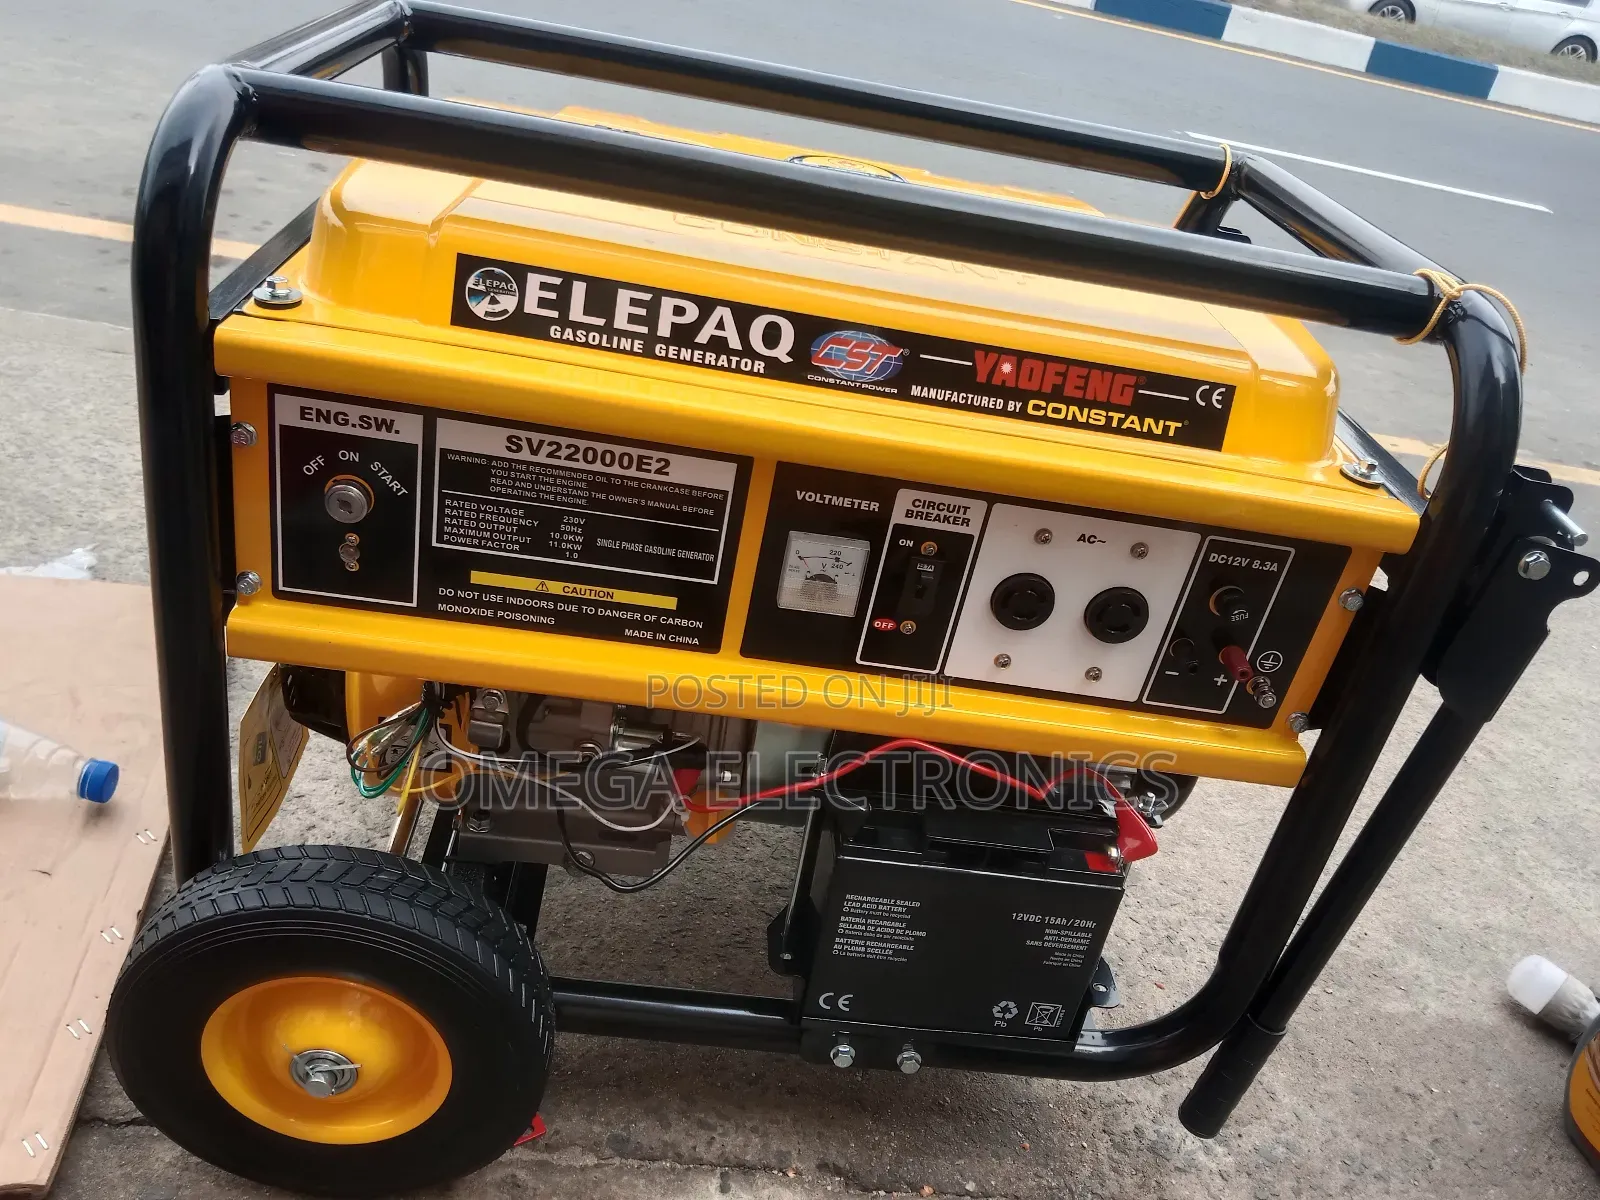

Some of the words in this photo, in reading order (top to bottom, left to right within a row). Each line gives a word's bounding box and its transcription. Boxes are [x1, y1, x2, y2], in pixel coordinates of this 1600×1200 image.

[472, 278, 516, 291] ELEPAQ
[524, 272, 795, 362] ELEPAQ
[549, 325, 644, 353] GASOLINE
[654, 344, 766, 374] GENERATOR
[811, 337, 903, 374] CST
[910, 384, 1004, 410] MANUFACTURED
[1006, 400, 1023, 413] BY
[300, 406, 400, 434] ENG.SW.
[303, 455, 325, 475] OFF
[338, 450, 359, 462] ON
[504, 434, 671, 476] SV22000E2
[370, 461, 408, 496] START
[447, 453, 489, 465] WARNING:
[492, 460, 509, 468] ADD
[510, 462, 527, 471] THE
[529, 465, 594, 481] RECOMMENDED
[595, 475, 608, 483] OIL
[622, 479, 639, 488] THE
[640, 482, 690, 495] CRANKCASE
[691, 489, 724, 500] BEFORE
[490, 469, 508, 477] YOU
[509, 471, 537, 480] START
[538, 475, 555, 484] THE
[556, 478, 588, 489] ENGINE.
[489, 486, 537, 498] OPERATING
[538, 492, 555, 501] THE
[556, 495, 589, 506] ENGINE.
[490, 477, 513, 486] READ
[534, 483, 589, 497] UNDERSTAND
[590, 491, 607, 500] THE
[608, 494, 646, 506] OWNER'S
[647, 500, 680, 511] MANUAL
[682, 505, 714, 516] BEFORE
[796, 490, 880, 512] VOLTMETER
[912, 498, 970, 515] CIRCUIT
[444, 508, 477, 519] RATED
[479, 512, 539, 527] FREQUENCY
[560, 524, 582, 534] 50Hz
[445, 499, 478, 510] RATED
[479, 503, 524, 517] VOLTAGE
[563, 515, 586, 524] 230V
[904, 509, 970, 527] BREAKER
[444, 517, 477, 528] RATED
[478, 521, 518, 533] OUTPUT
[550, 532, 584, 542] 10.0KW
[444, 526, 490, 538] MAXIMUM
[492, 532, 532, 544] OUTPUT
[548, 540, 582, 551] 11.0KW
[443, 534, 479, 546] POWER
[481, 539, 520, 551] FACTOR
[596, 538, 620, 549] SINGLE
[621, 541, 643, 552] PHASE
[644, 544, 676, 557] GASOLINE
[677, 549, 714, 562] GENERATOR
[899, 538, 914, 547] ON
[1208, 553, 1250, 567] DC12V
[1252, 560, 1278, 572] 8.3A
[562, 586, 614, 600] CAUTION
[438, 587, 454, 596] DO
[457, 590, 480, 600] NOT
[482, 593, 504, 603] USE
[506, 596, 554, 609] INDOORS
[557, 602, 579, 612] DUE
[581, 605, 595, 614] TO
[597, 608, 641, 620] DANGER
[643, 614, 658, 622] OF
[659, 616, 703, 628] CARBON
[438, 603, 494, 617] MONOXIDE
[497, 610, 555, 625] POISONING
[1231, 612, 1249, 622] FUSE
[874, 620, 894, 630] OFF
[624, 628, 654, 639] MADE
[668, 634, 699, 645] CHINA
[878, 904, 907, 912] BATTERY
[1012, 912, 1042, 923] 12VDC
